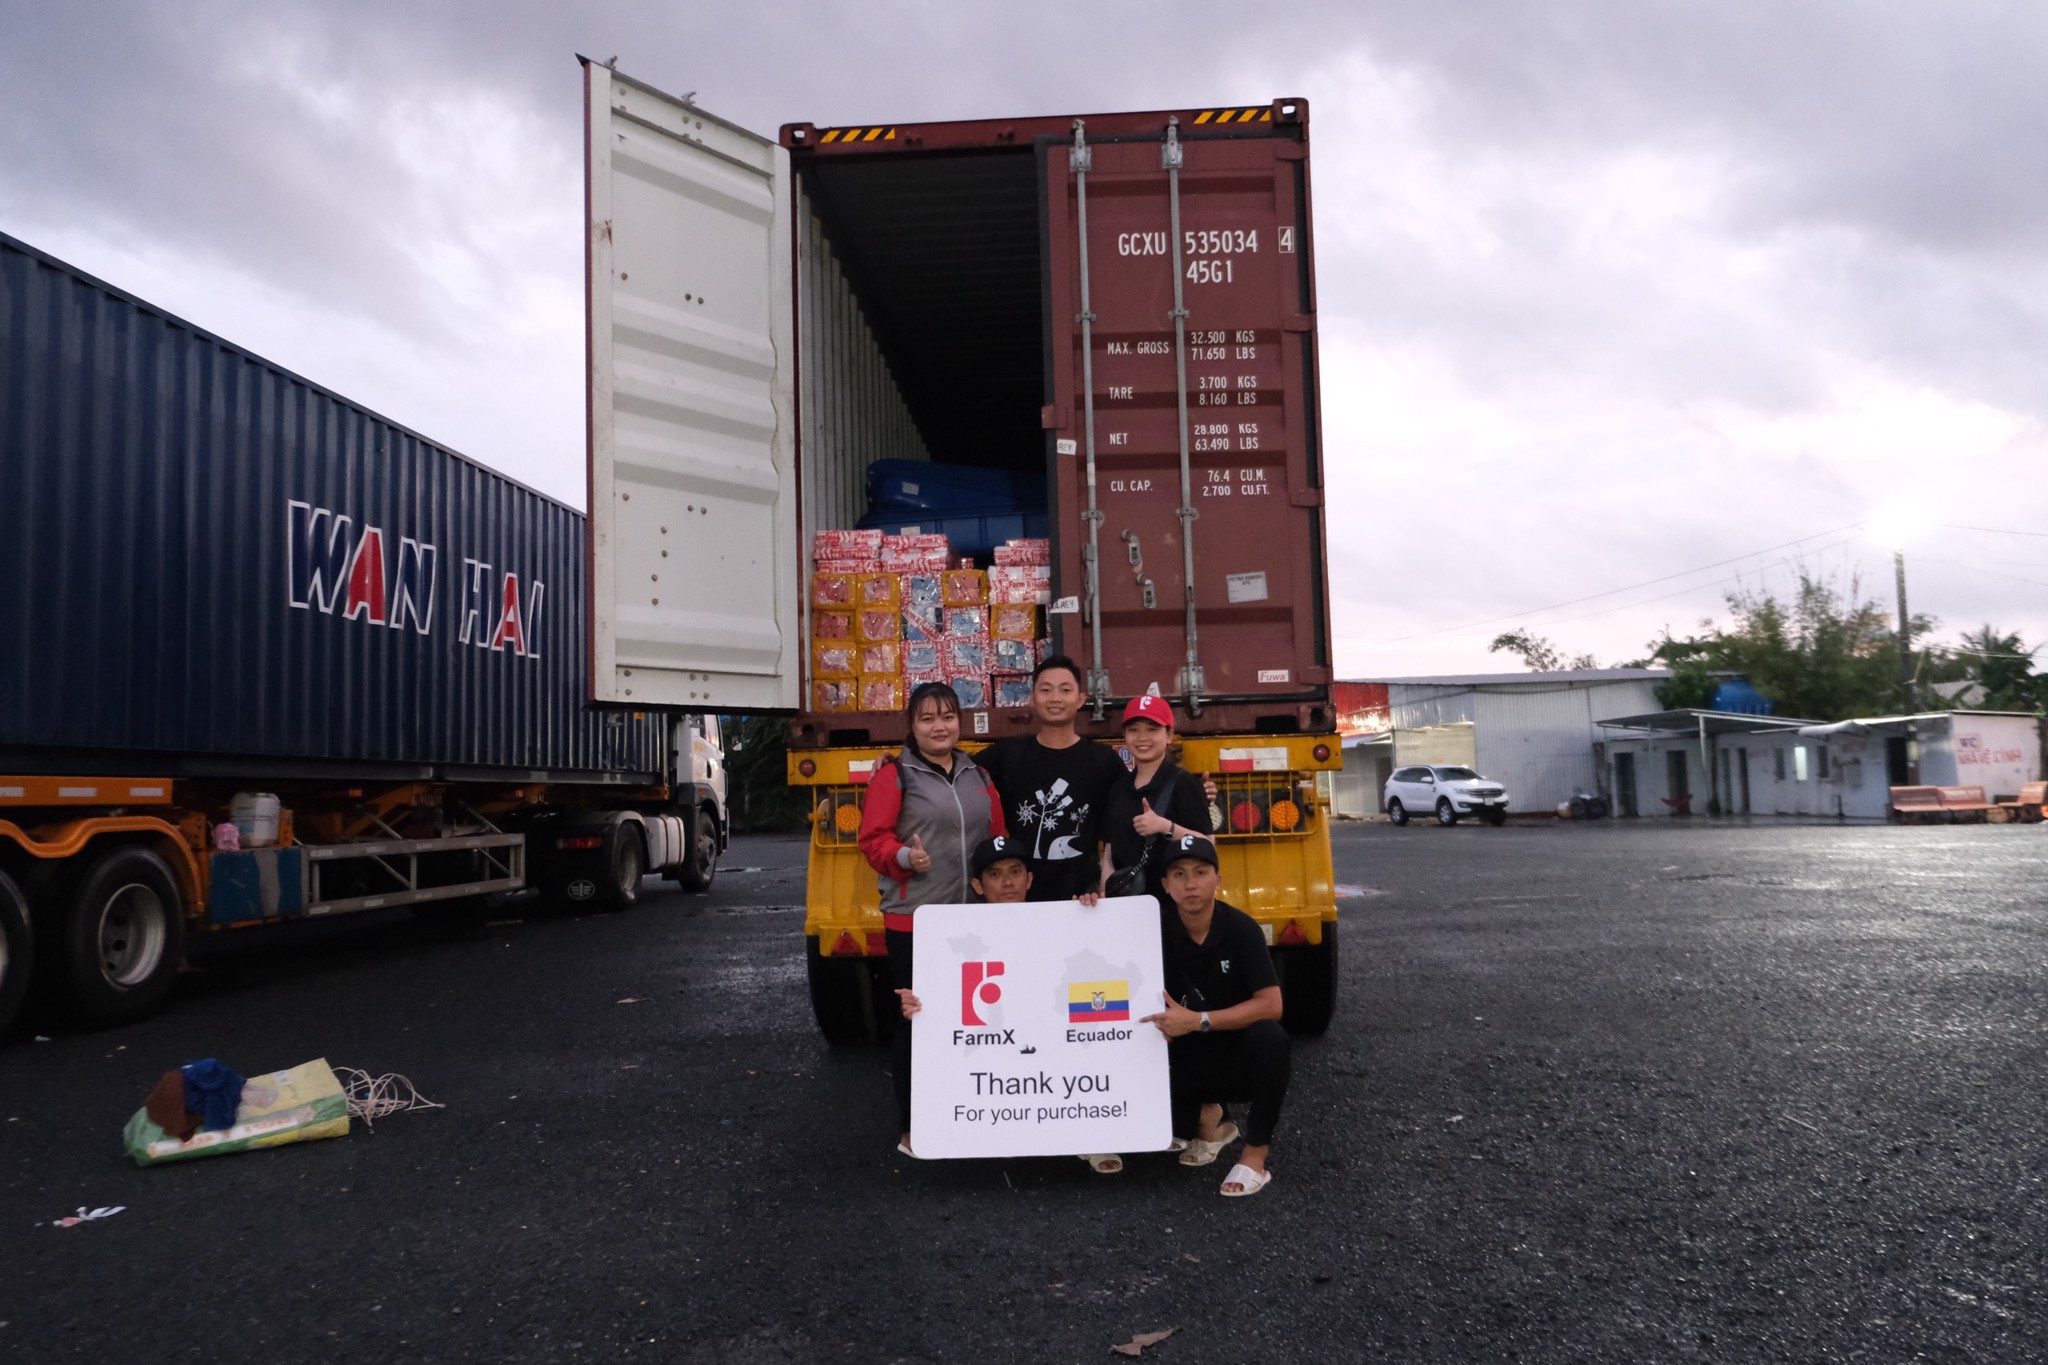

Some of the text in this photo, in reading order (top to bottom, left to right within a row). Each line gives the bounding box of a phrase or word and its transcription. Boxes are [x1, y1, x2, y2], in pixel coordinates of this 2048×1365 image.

[1118, 228, 1293, 256] GCXU 535034 4
[1186, 260, 1232, 283] 45G1
[1191, 330, 1255, 344] 32.500 KGS
[1107, 342, 1169, 354] MAX. GROSS
[1192, 347, 1255, 361] 71.650 LBS
[1199, 376, 1257, 389] 3.700 KGS
[1109, 387, 1133, 399] TARE
[1199, 392, 1256, 405] 8.160 LBS
[1194, 424, 1258, 435] 28.800 KGS
[1110, 433, 1128, 444] NET
[1195, 437, 1259, 450] 63.490 LBS
[1208, 470, 1230, 482] 76.4
[1111, 480, 1153, 491] CU. CAP.
[1203, 486, 1231, 496] 2.700
[288, 499, 544, 658] WAN HAI
[1260, 671, 1285, 681] Fuwa
[952, 1028, 1133, 1046] FarmX Ecuador
[969, 1071, 1110, 1100] Thank you
[954, 1101, 1128, 1125] For your purchase!
